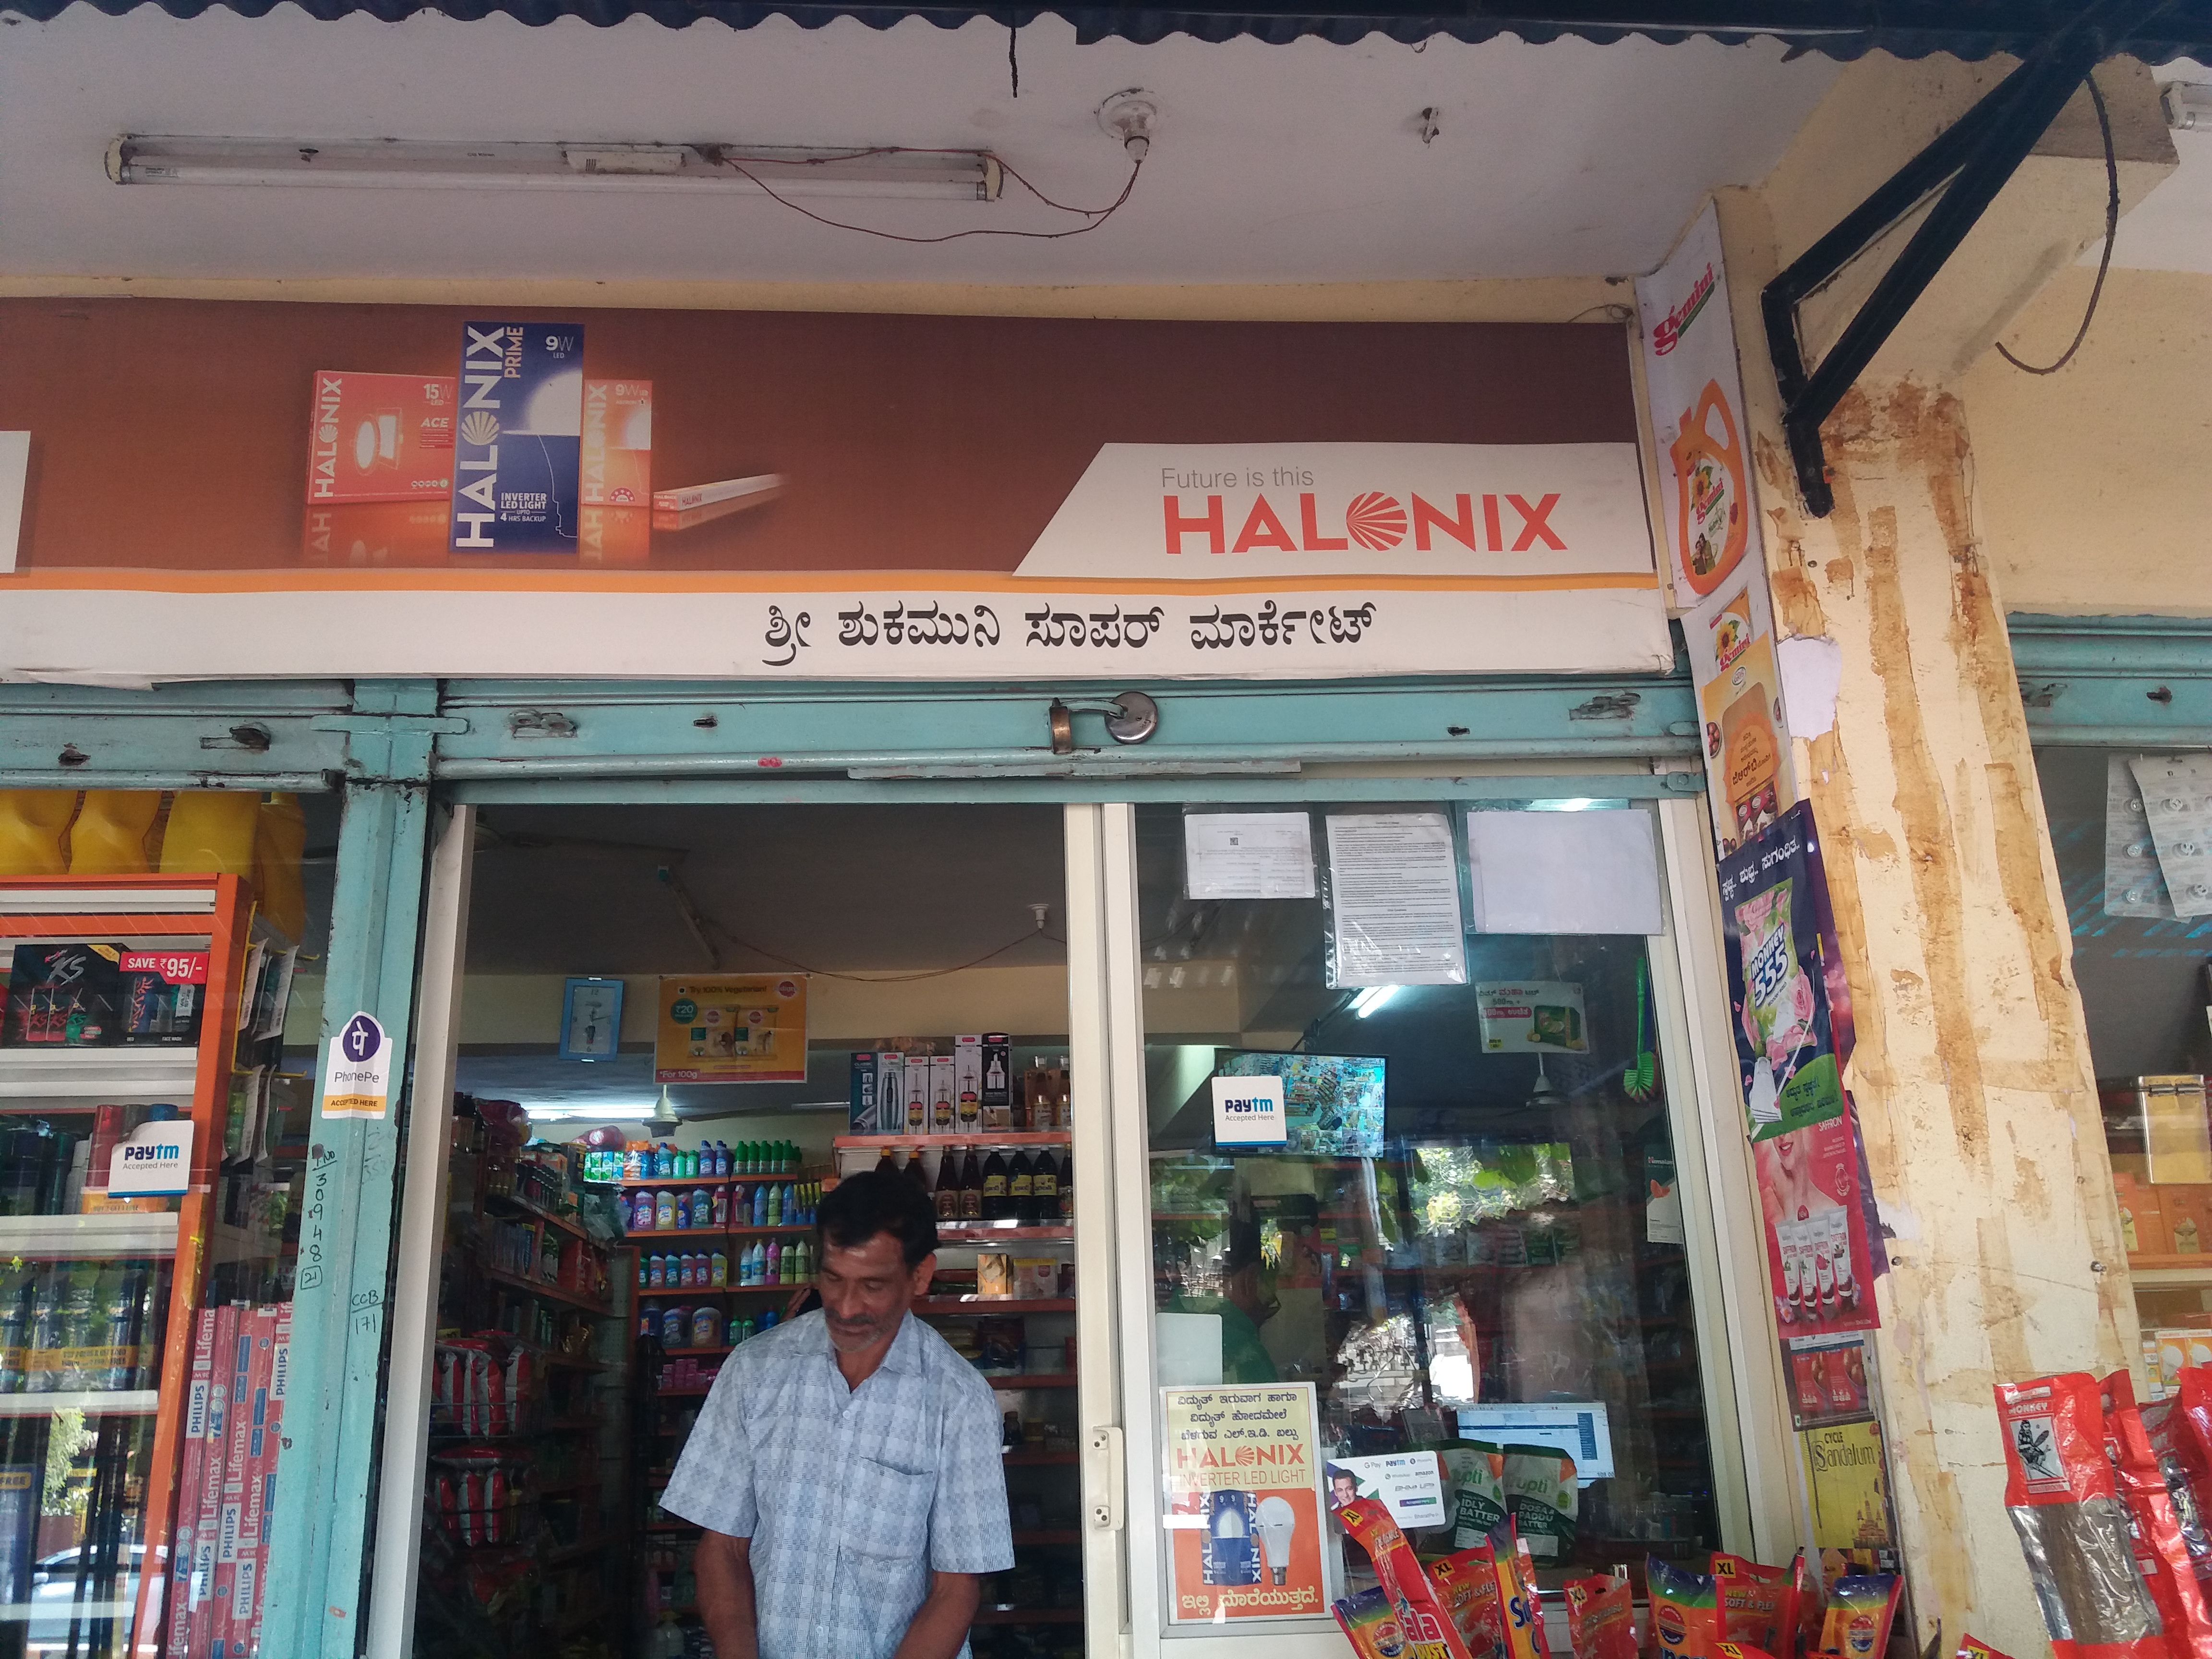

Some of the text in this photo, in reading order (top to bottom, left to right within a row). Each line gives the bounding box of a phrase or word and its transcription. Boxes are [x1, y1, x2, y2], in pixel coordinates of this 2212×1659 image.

[545, 336, 574, 352] 9W
[504, 326, 523, 379] PRIME
[423, 383, 453, 400] 15W
[615, 384, 639, 397] 9W
[420, 417, 450, 428] ACE
[314, 377, 343, 499] HALONIX
[455, 325, 505, 548] HALONIX
[1161, 467, 1315, 489] Future is this
[500, 492, 547, 501] INVERTER
[500, 501, 547, 510] LED LIGHT
[500, 513, 507, 522] 4
[1163, 491, 1569, 554] HALONIX
[762, 602, 812, 667] ಶ್ರೀ
[838, 600, 1001, 648] ಶುಕಮುನಿ
[1024, 602, 1166, 649] ಸೂಪರ್
[1751, 923, 1785, 980] MONKEY
[127, 957, 156, 969] SAVE
[1755, 941, 1789, 1008] 555
[334, 1071, 380, 1083] PhonePe
[331, 1098, 359, 1106] ACCEPTED
[1225, 1114, 1257, 1122] Accepted
[1818, 1116, 1843, 1132] SAFFRON
[122, 1162, 158, 1171] Accepted
[304, 1271, 317, 1284] 21
[352, 1289, 379, 1306] CCB
[356, 1313, 376, 1335] 171
[195, 1309, 216, 1360] Lifema
[276, 1347, 288, 1396] PHILIPS
[191, 1385, 204, 1433] PHILIPS
[1824, 1431, 1844, 1444] CYCLE
[229, 1420, 247, 1483] Lifemax
[1177, 1443, 1305, 1468] HALONIX
[1180, 1469, 1306, 1487] INVERTER LED LIGHT
[202, 1456, 222, 1519] Lifemax
[243, 1474, 263, 1538] Lifemax
[1461, 1498, 1485, 1510] IDLY
[1520, 1503, 1547, 1512] DOSA
[1345, 1511, 1360, 1523] XL
[1460, 1507, 1502, 1523] BATTER
[1518, 1520, 1548, 1529] BATTER
[223, 1508, 237, 1559] PHILIPS
[199, 1545, 211, 1598] PHILIPS
[1434, 1562, 1453, 1574] XL
[1718, 1562, 1735, 1575] XL
[239, 1563, 252, 1615] PHILIPS
[1722, 1644, 1741, 1656] XL
